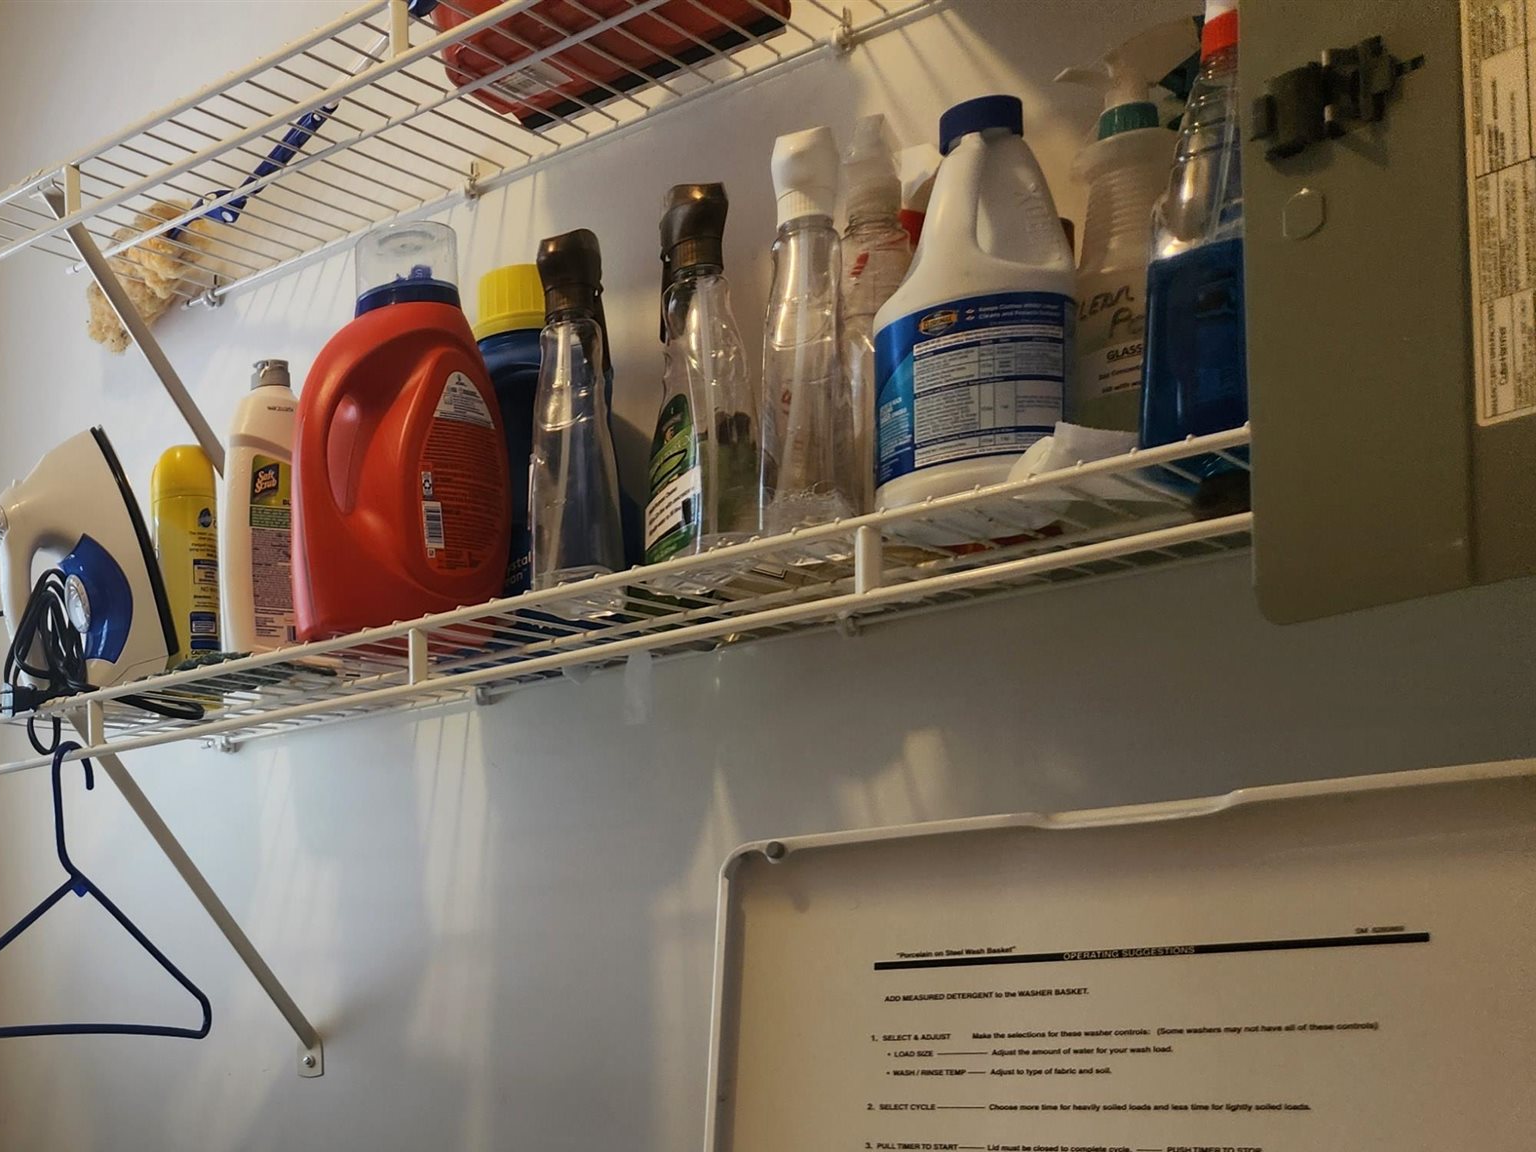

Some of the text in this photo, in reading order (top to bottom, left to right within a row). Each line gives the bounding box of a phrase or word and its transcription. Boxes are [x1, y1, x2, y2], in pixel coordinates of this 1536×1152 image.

[1107, 344, 1142, 360] GLASS
[1063, 946, 1196, 961] OPERATING SUGGESTIONS
[1225, 1104, 1252, 1112] lightly
